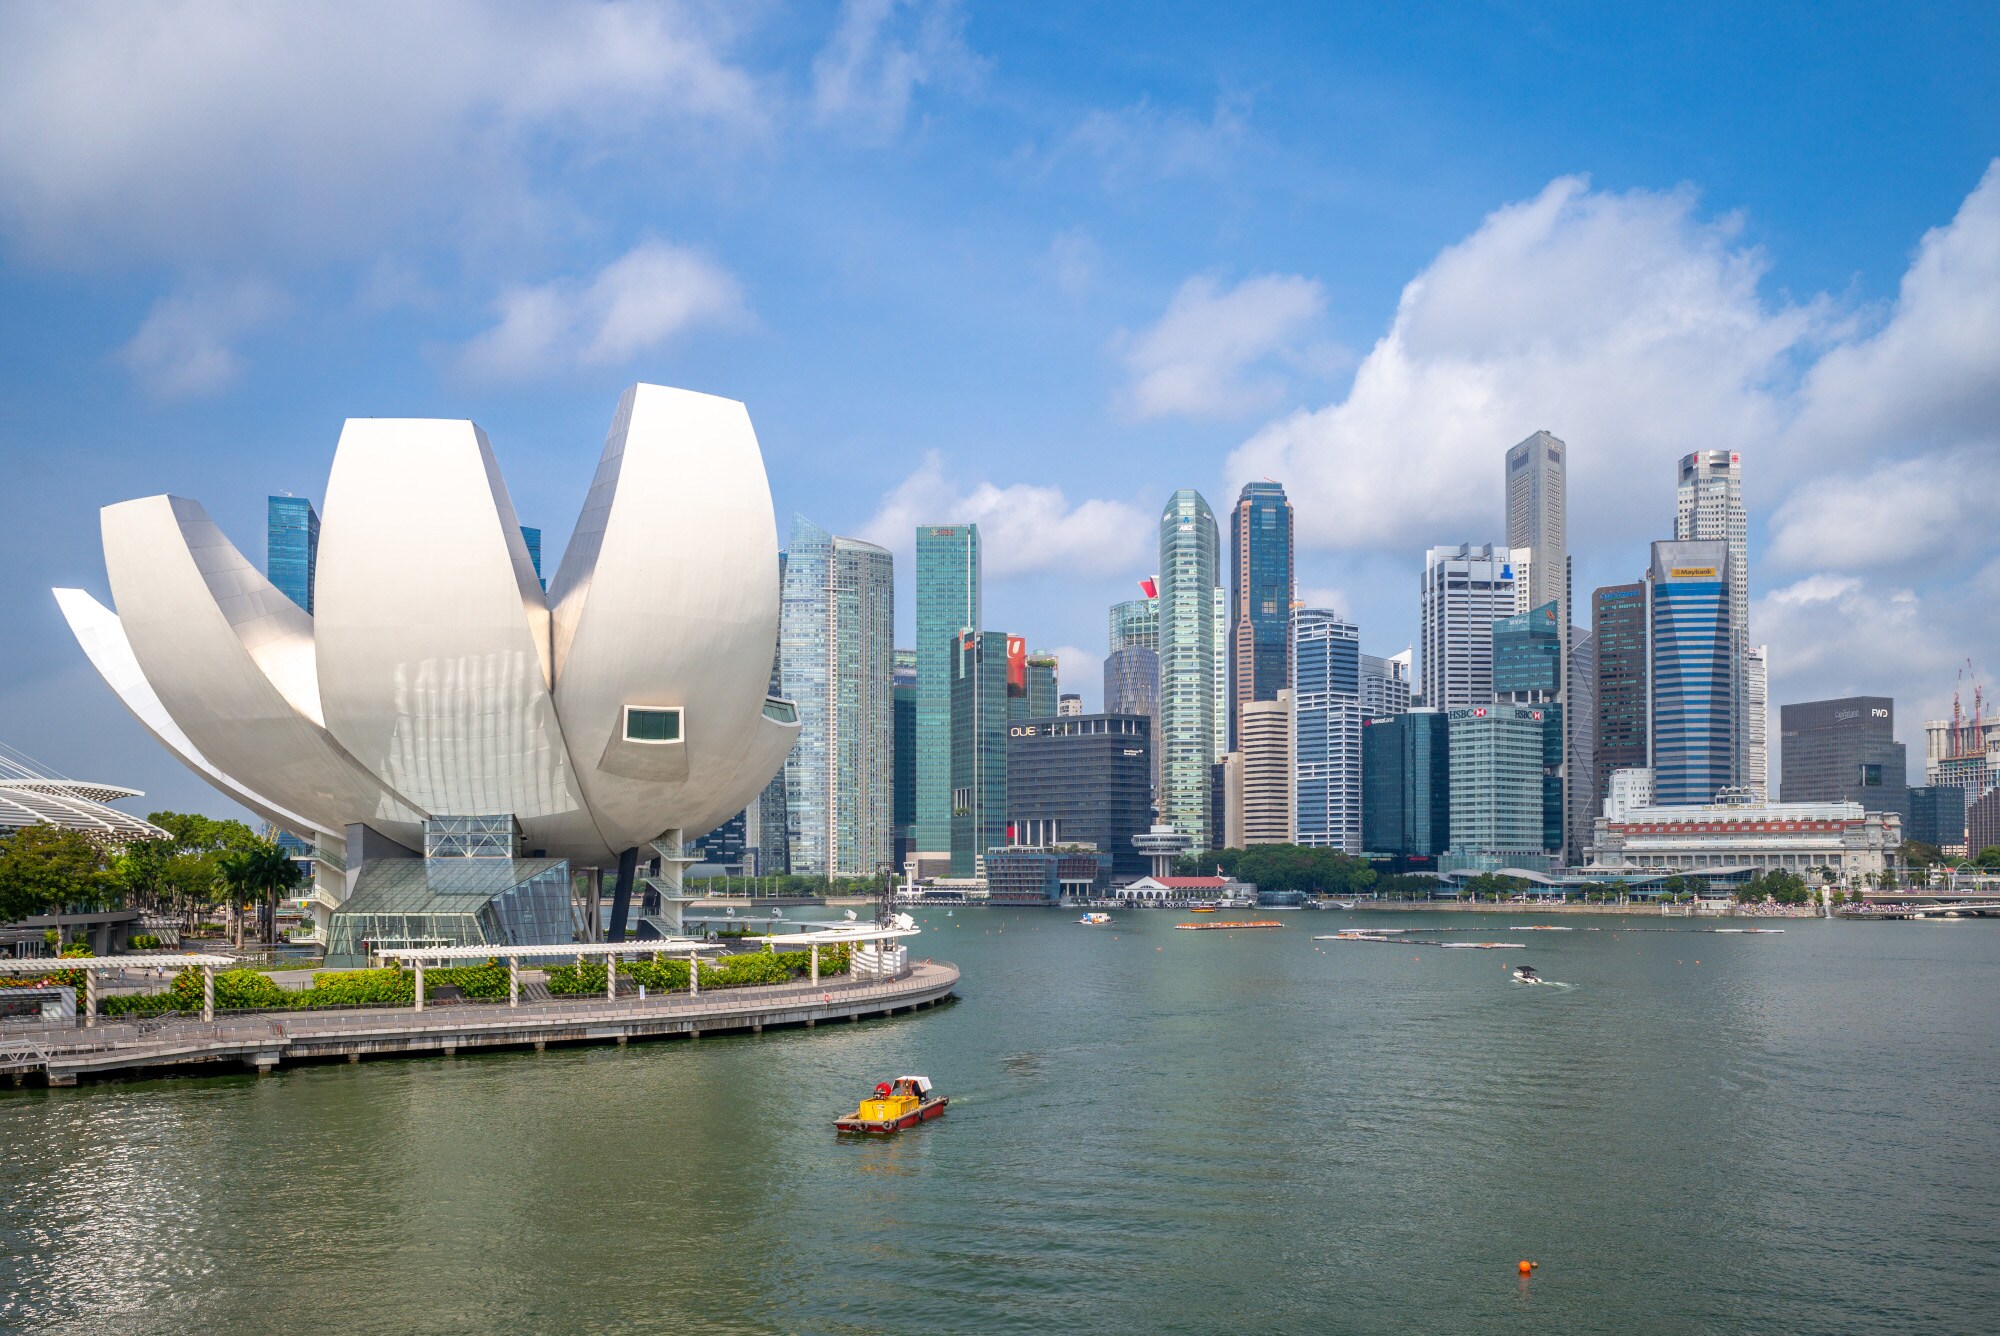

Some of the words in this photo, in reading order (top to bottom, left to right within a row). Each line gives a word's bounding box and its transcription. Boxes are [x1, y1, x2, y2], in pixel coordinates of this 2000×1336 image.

[1449, 709, 1473, 720] HSBC
[1515, 710, 1532, 719] HSBC
[1871, 708, 1888, 718] FWD
[1010, 726, 1036, 737] OUE
